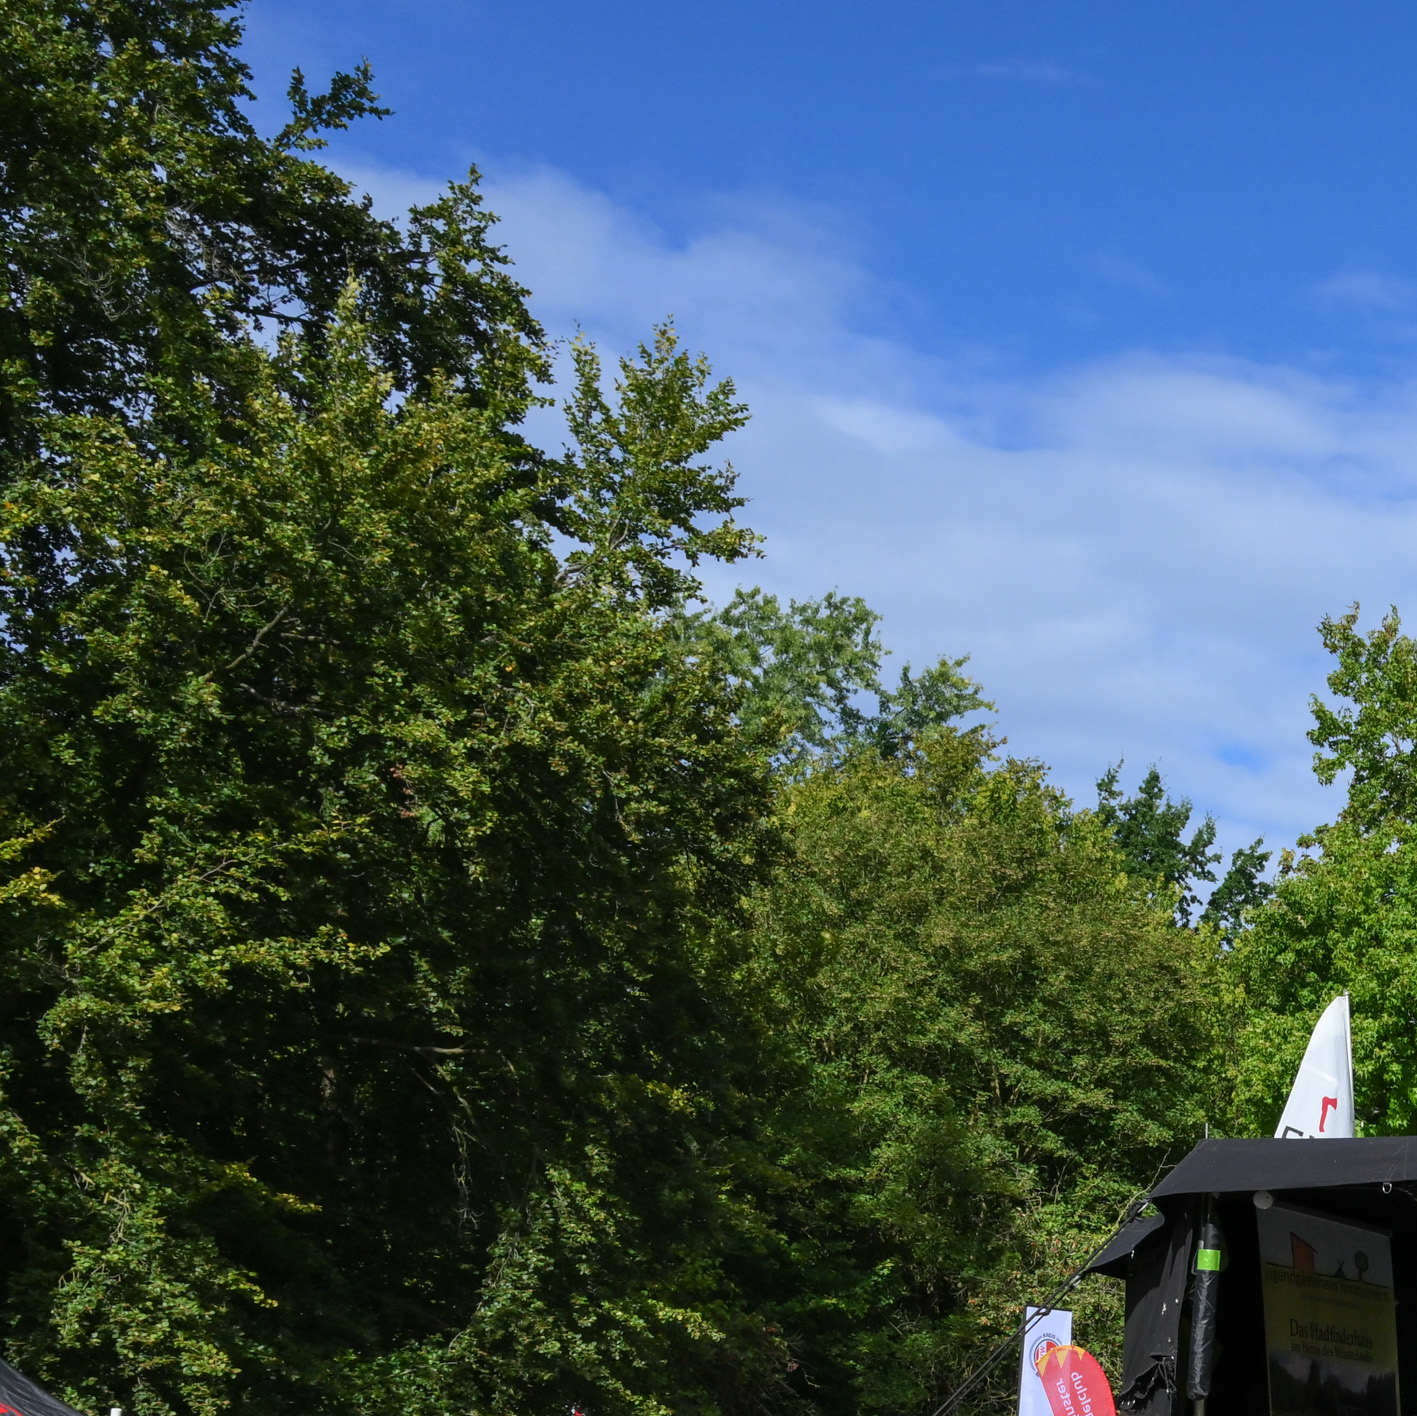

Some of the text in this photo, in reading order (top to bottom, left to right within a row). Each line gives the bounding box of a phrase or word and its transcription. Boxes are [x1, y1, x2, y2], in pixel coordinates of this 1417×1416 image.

[1289, 1318, 1374, 1348] Das Pfadfinderhaus
[1322, 1343, 1333, 1356] des
